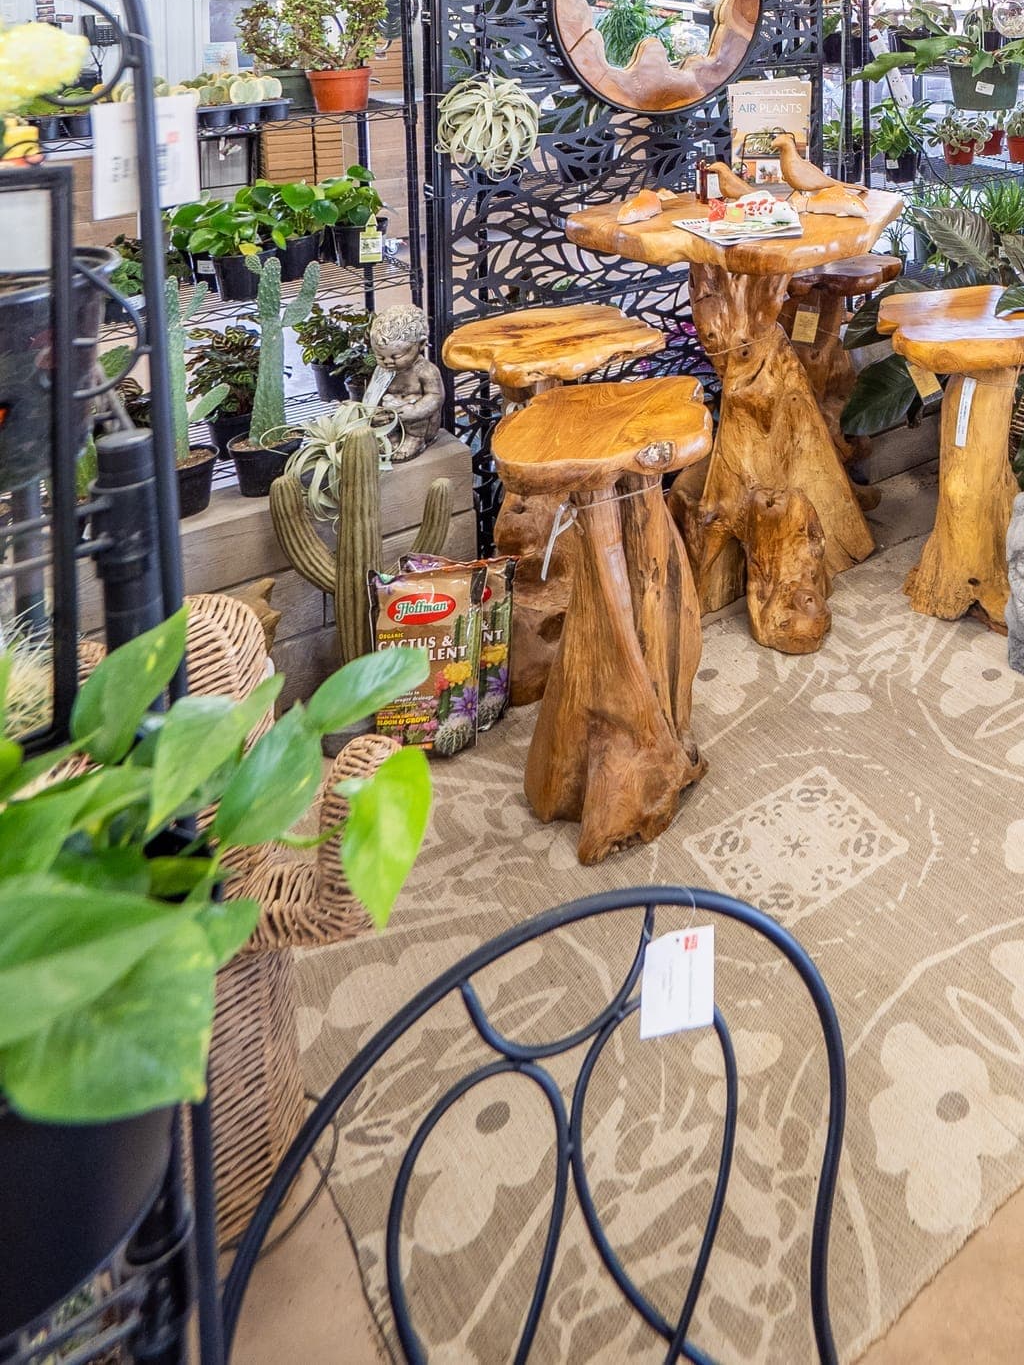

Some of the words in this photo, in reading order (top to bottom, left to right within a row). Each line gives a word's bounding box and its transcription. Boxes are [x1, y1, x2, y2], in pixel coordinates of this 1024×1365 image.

[738, 103, 757, 113] AIR
[760, 103, 802, 114] PLANTS
[394, 600, 448, 622] Hoffman
[378, 632, 405, 640] ORGANIC
[442, 635, 453, 646] &
